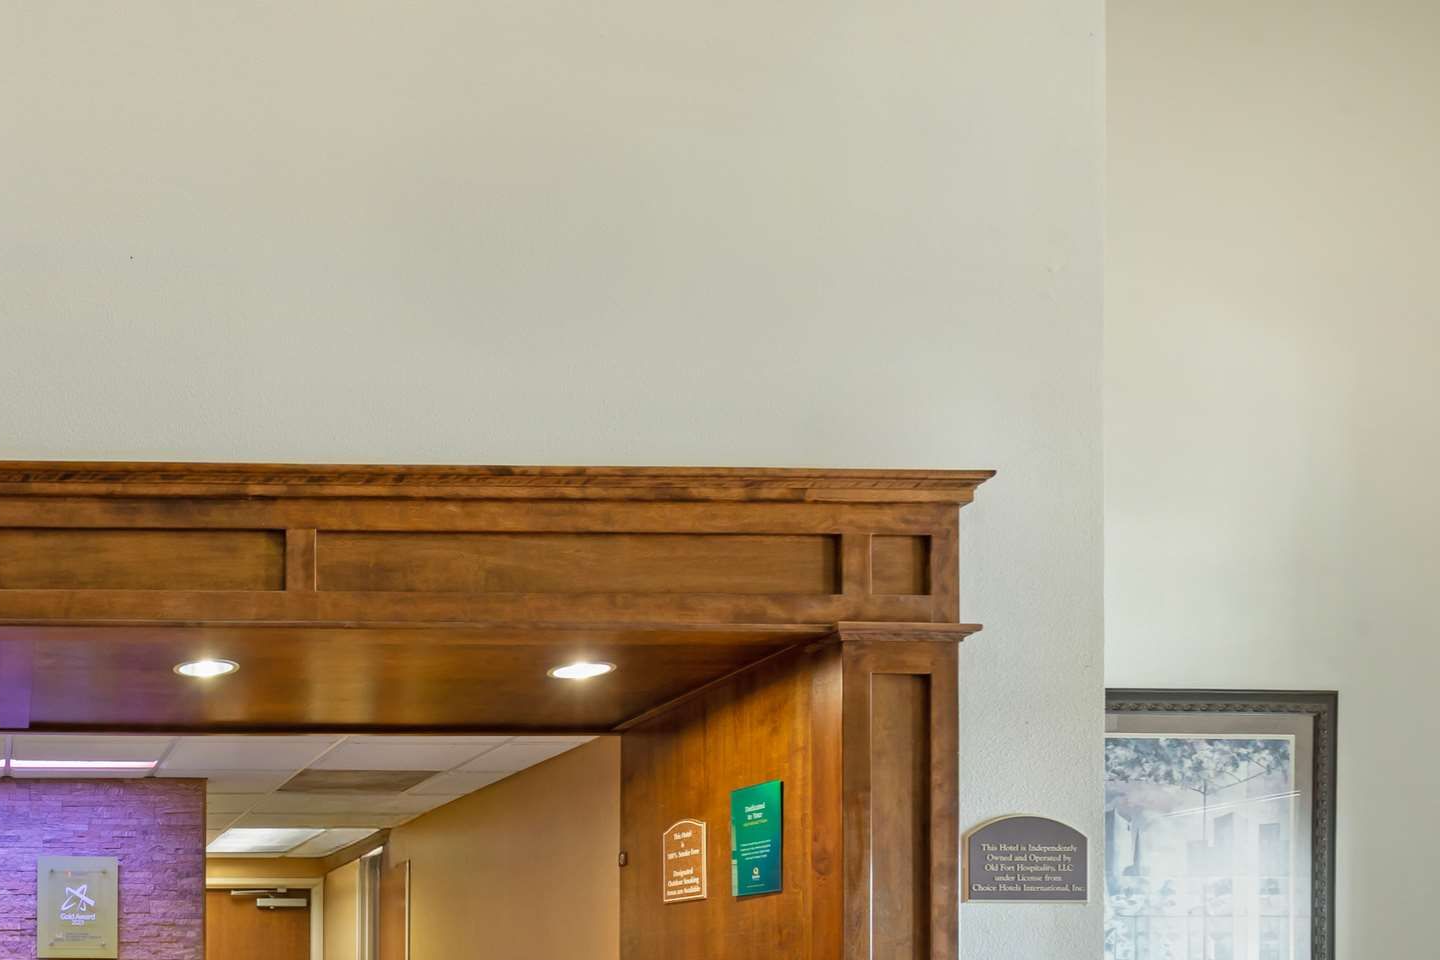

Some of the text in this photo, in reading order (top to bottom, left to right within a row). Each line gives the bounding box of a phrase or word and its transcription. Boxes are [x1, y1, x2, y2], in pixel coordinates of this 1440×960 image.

[981, 844, 997, 852] This
[999, 844, 1019, 852] Hotel
[1028, 844, 1078, 853] Independently
[1029, 854, 1061, 863] Operated
[1063, 854, 1072, 863] by
[984, 864, 1073, 873] Old Fort Hospitality, LLC
[972, 884, 997, 892] Choice
[998, 884, 1020, 892] Hotels
[1023, 884, 1070, 892] International,
[60, 912, 96, 921] Gold Award
